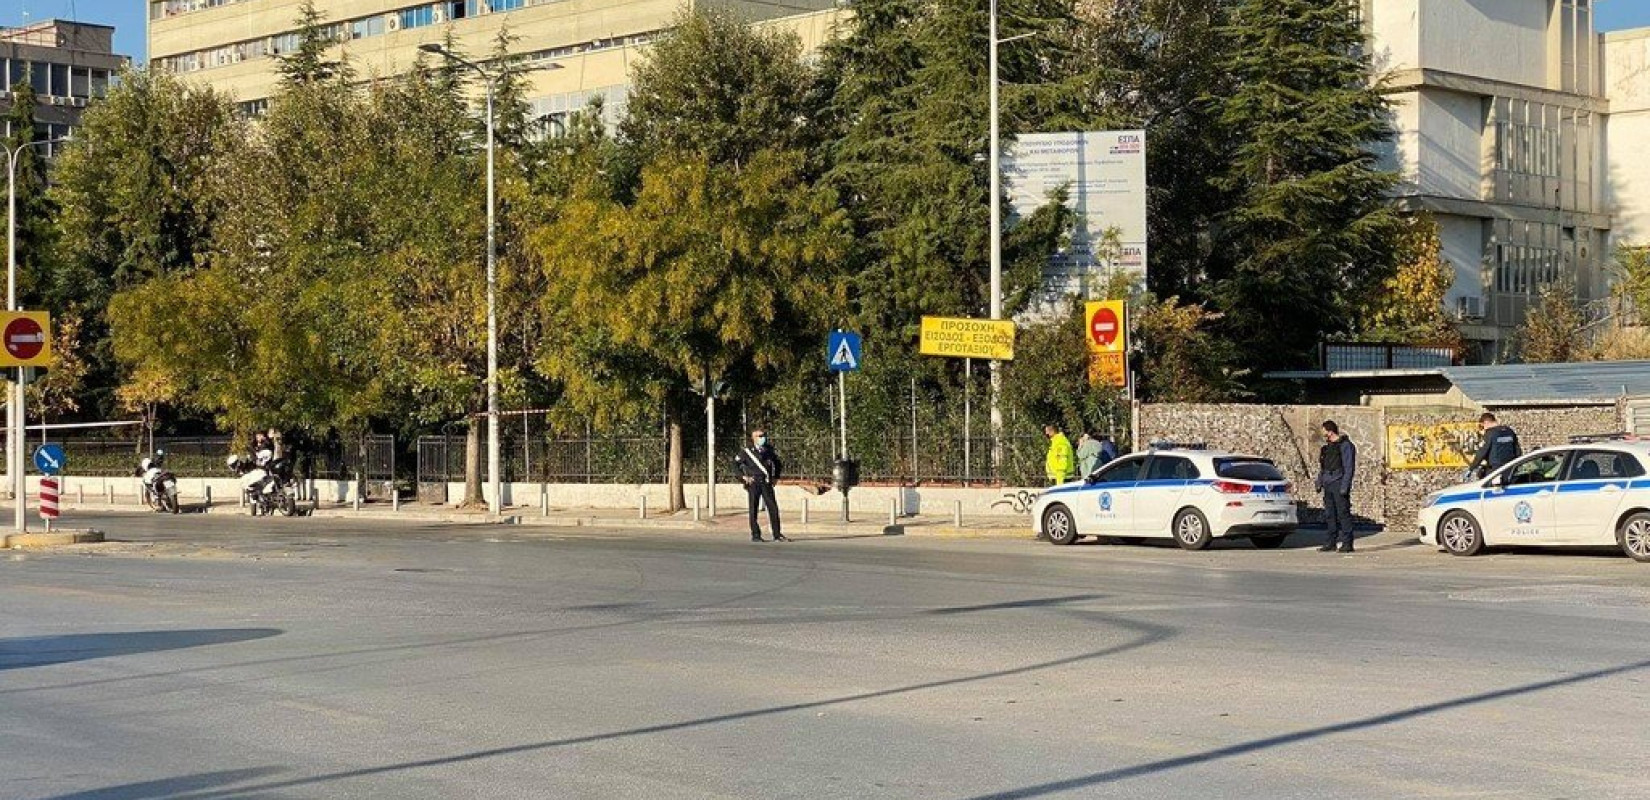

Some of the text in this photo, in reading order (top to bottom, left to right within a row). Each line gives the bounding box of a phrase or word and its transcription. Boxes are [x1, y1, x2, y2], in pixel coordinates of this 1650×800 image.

[1118, 135, 1140, 143] ΕΣΠΑ
[941, 321, 995, 332] ΠΡΟΣΟΧΗ
[924, 331, 964, 342] ΕΙΣΟΔΟΣ
[938, 342, 994, 355] ΕΡΓΟΤΑΞΙΟΥ
